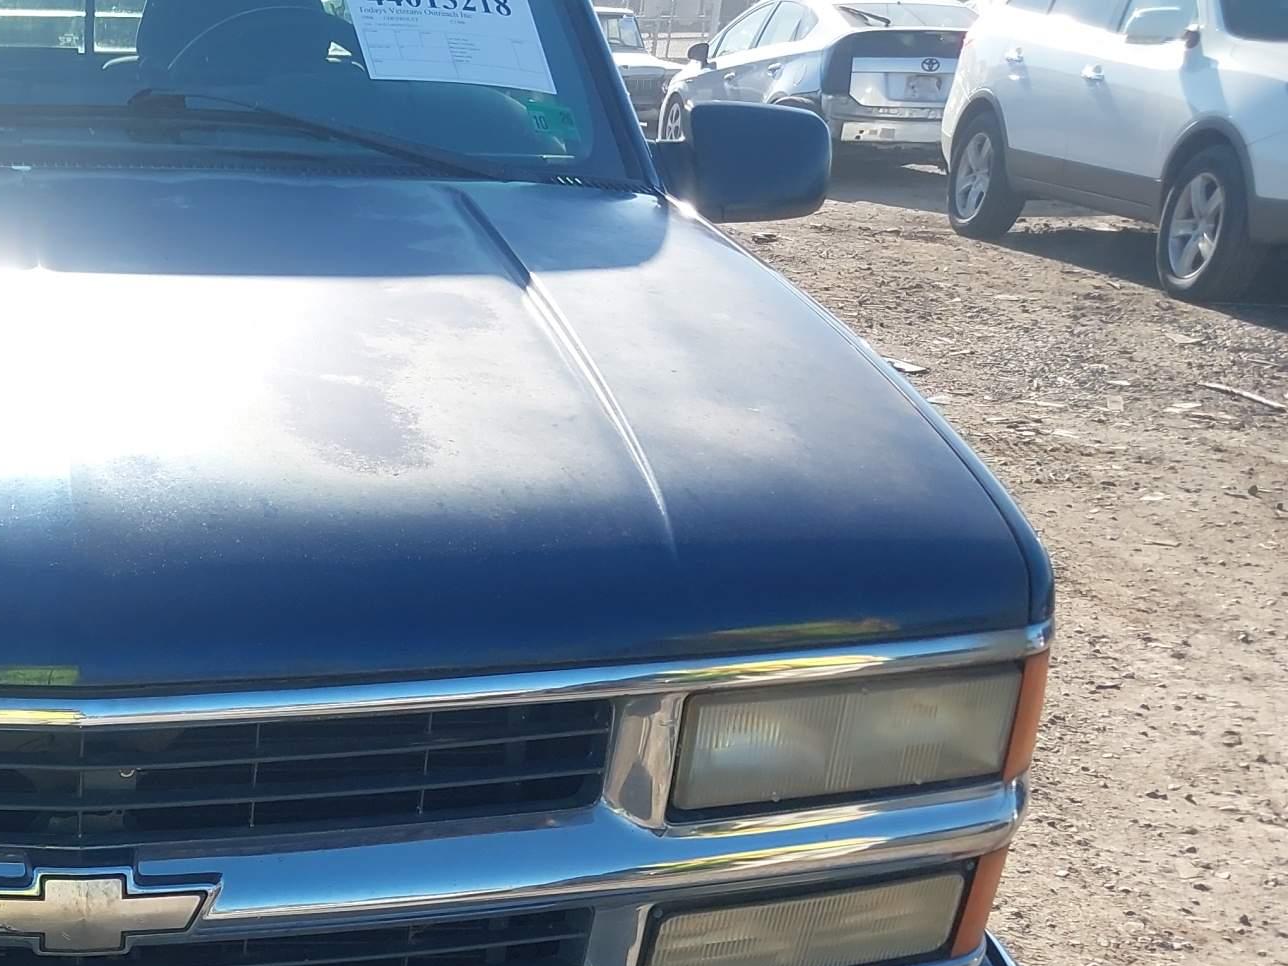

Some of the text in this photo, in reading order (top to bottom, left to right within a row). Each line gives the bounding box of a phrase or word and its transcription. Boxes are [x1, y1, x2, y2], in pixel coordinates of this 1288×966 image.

[359, 7, 386, 15] Todays
[367, 0, 512, 16] 3218
[533, 115, 549, 130] 10
